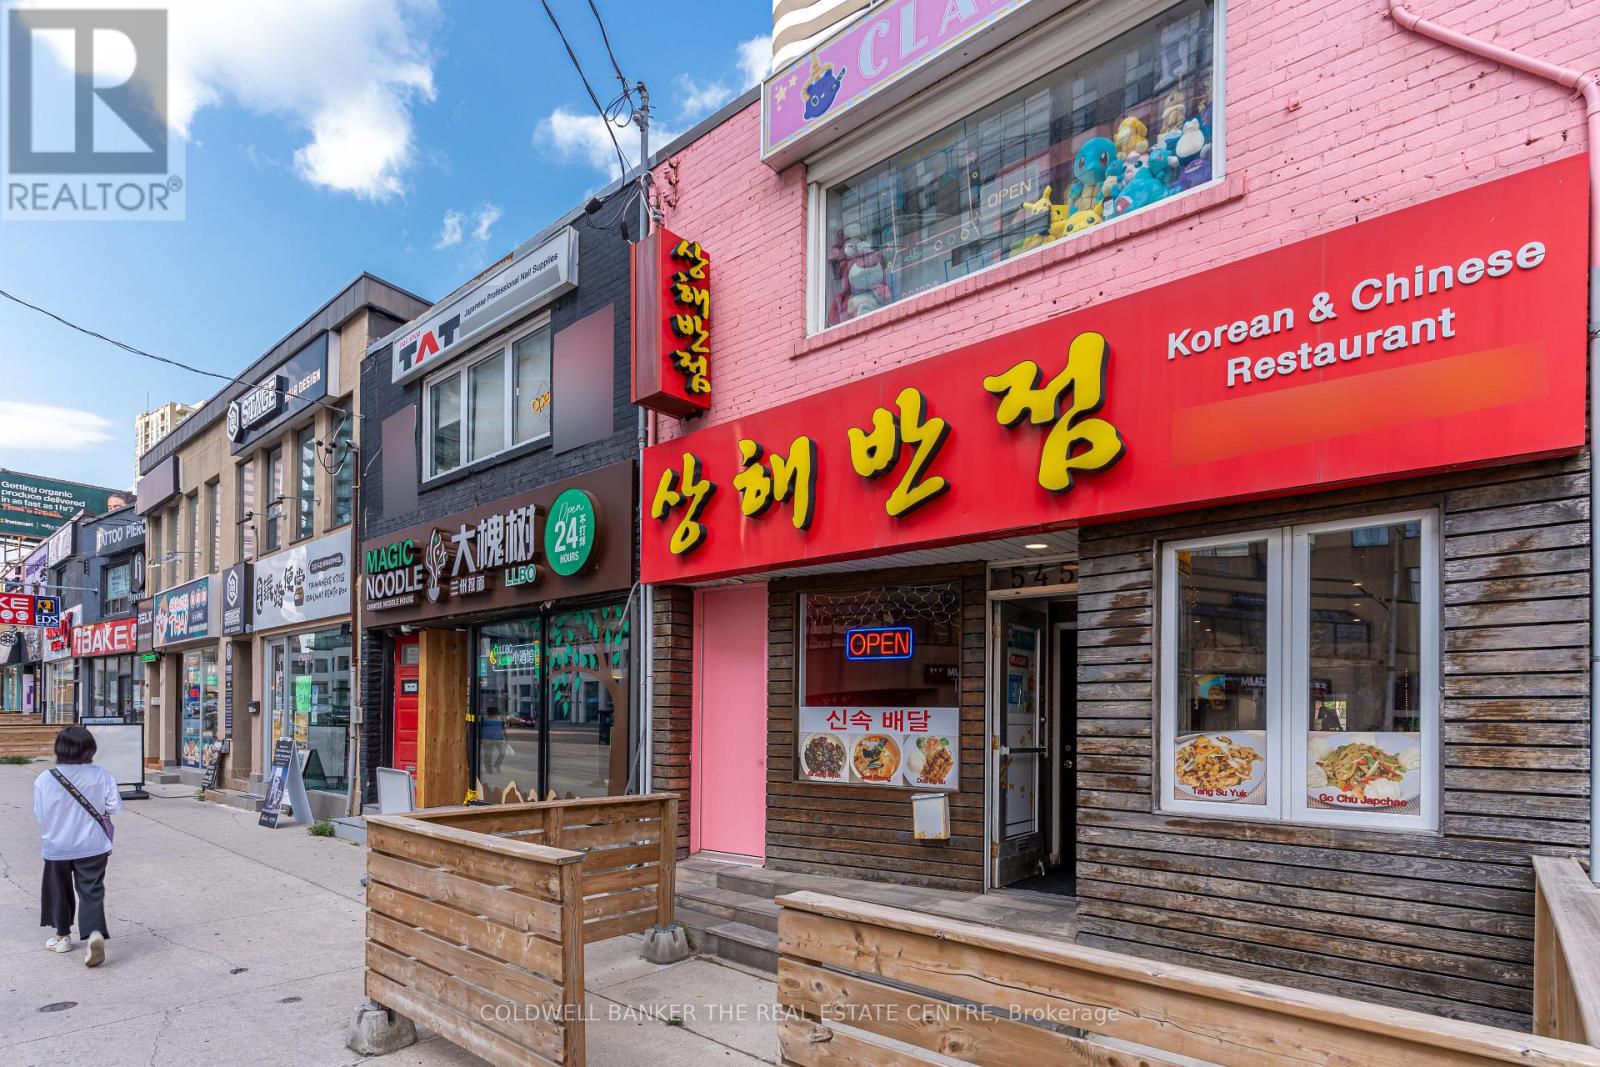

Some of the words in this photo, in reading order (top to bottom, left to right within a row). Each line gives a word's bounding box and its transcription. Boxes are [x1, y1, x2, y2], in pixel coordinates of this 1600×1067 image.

[858, 0, 1001, 79] CLA
[987, 178, 1032, 208] OPEN
[463, 298, 486, 318] Japanese
[486, 275, 520, 303] Professional
[520, 267, 532, 283] Nail
[532, 251, 559, 275] Supplies
[1167, 305, 1294, 360] Korean
[1308, 290, 1337, 323] &
[1350, 240, 1547, 311] Chinese
[399, 313, 461, 373] TAT
[1226, 306, 1457, 387] Restaurant
[298, 367, 321, 395] DESIGN
[241, 380, 276, 426] STAGE
[1, 480, 38, 494] Getting
[38, 487, 73, 499] organic
[1, 489, 43, 501] produce
[43, 494, 86, 507] delivered
[24, 499, 41, 508] fast
[558, 501, 585, 524] Open
[98, 526, 123, 548] TATTOO
[451, 503, 537, 577] 大槐树
[554, 516, 579, 553] 24
[365, 538, 415, 575] MAGIC
[559, 550, 580, 564] HOURS
[365, 563, 424, 600] NOODLE
[504, 563, 537, 587] LLBO
[1011, 562, 1075, 588] 545
[366, 601, 382, 610] CHINESE
[399, 594, 414, 605] HOUSE
[849, 631, 910, 656] OPEN
[826, 708, 873, 731] 신속
[882, 709, 932, 733] 배달
[1192, 786, 1214, 797] Tang
[1215, 788, 1228, 797] Su
[1229, 788, 1248, 798] Yuk
[1319, 793, 1334, 802] Go
[1336, 794, 1358, 804] Chu
[1360, 796, 1409, 808] Japchae
